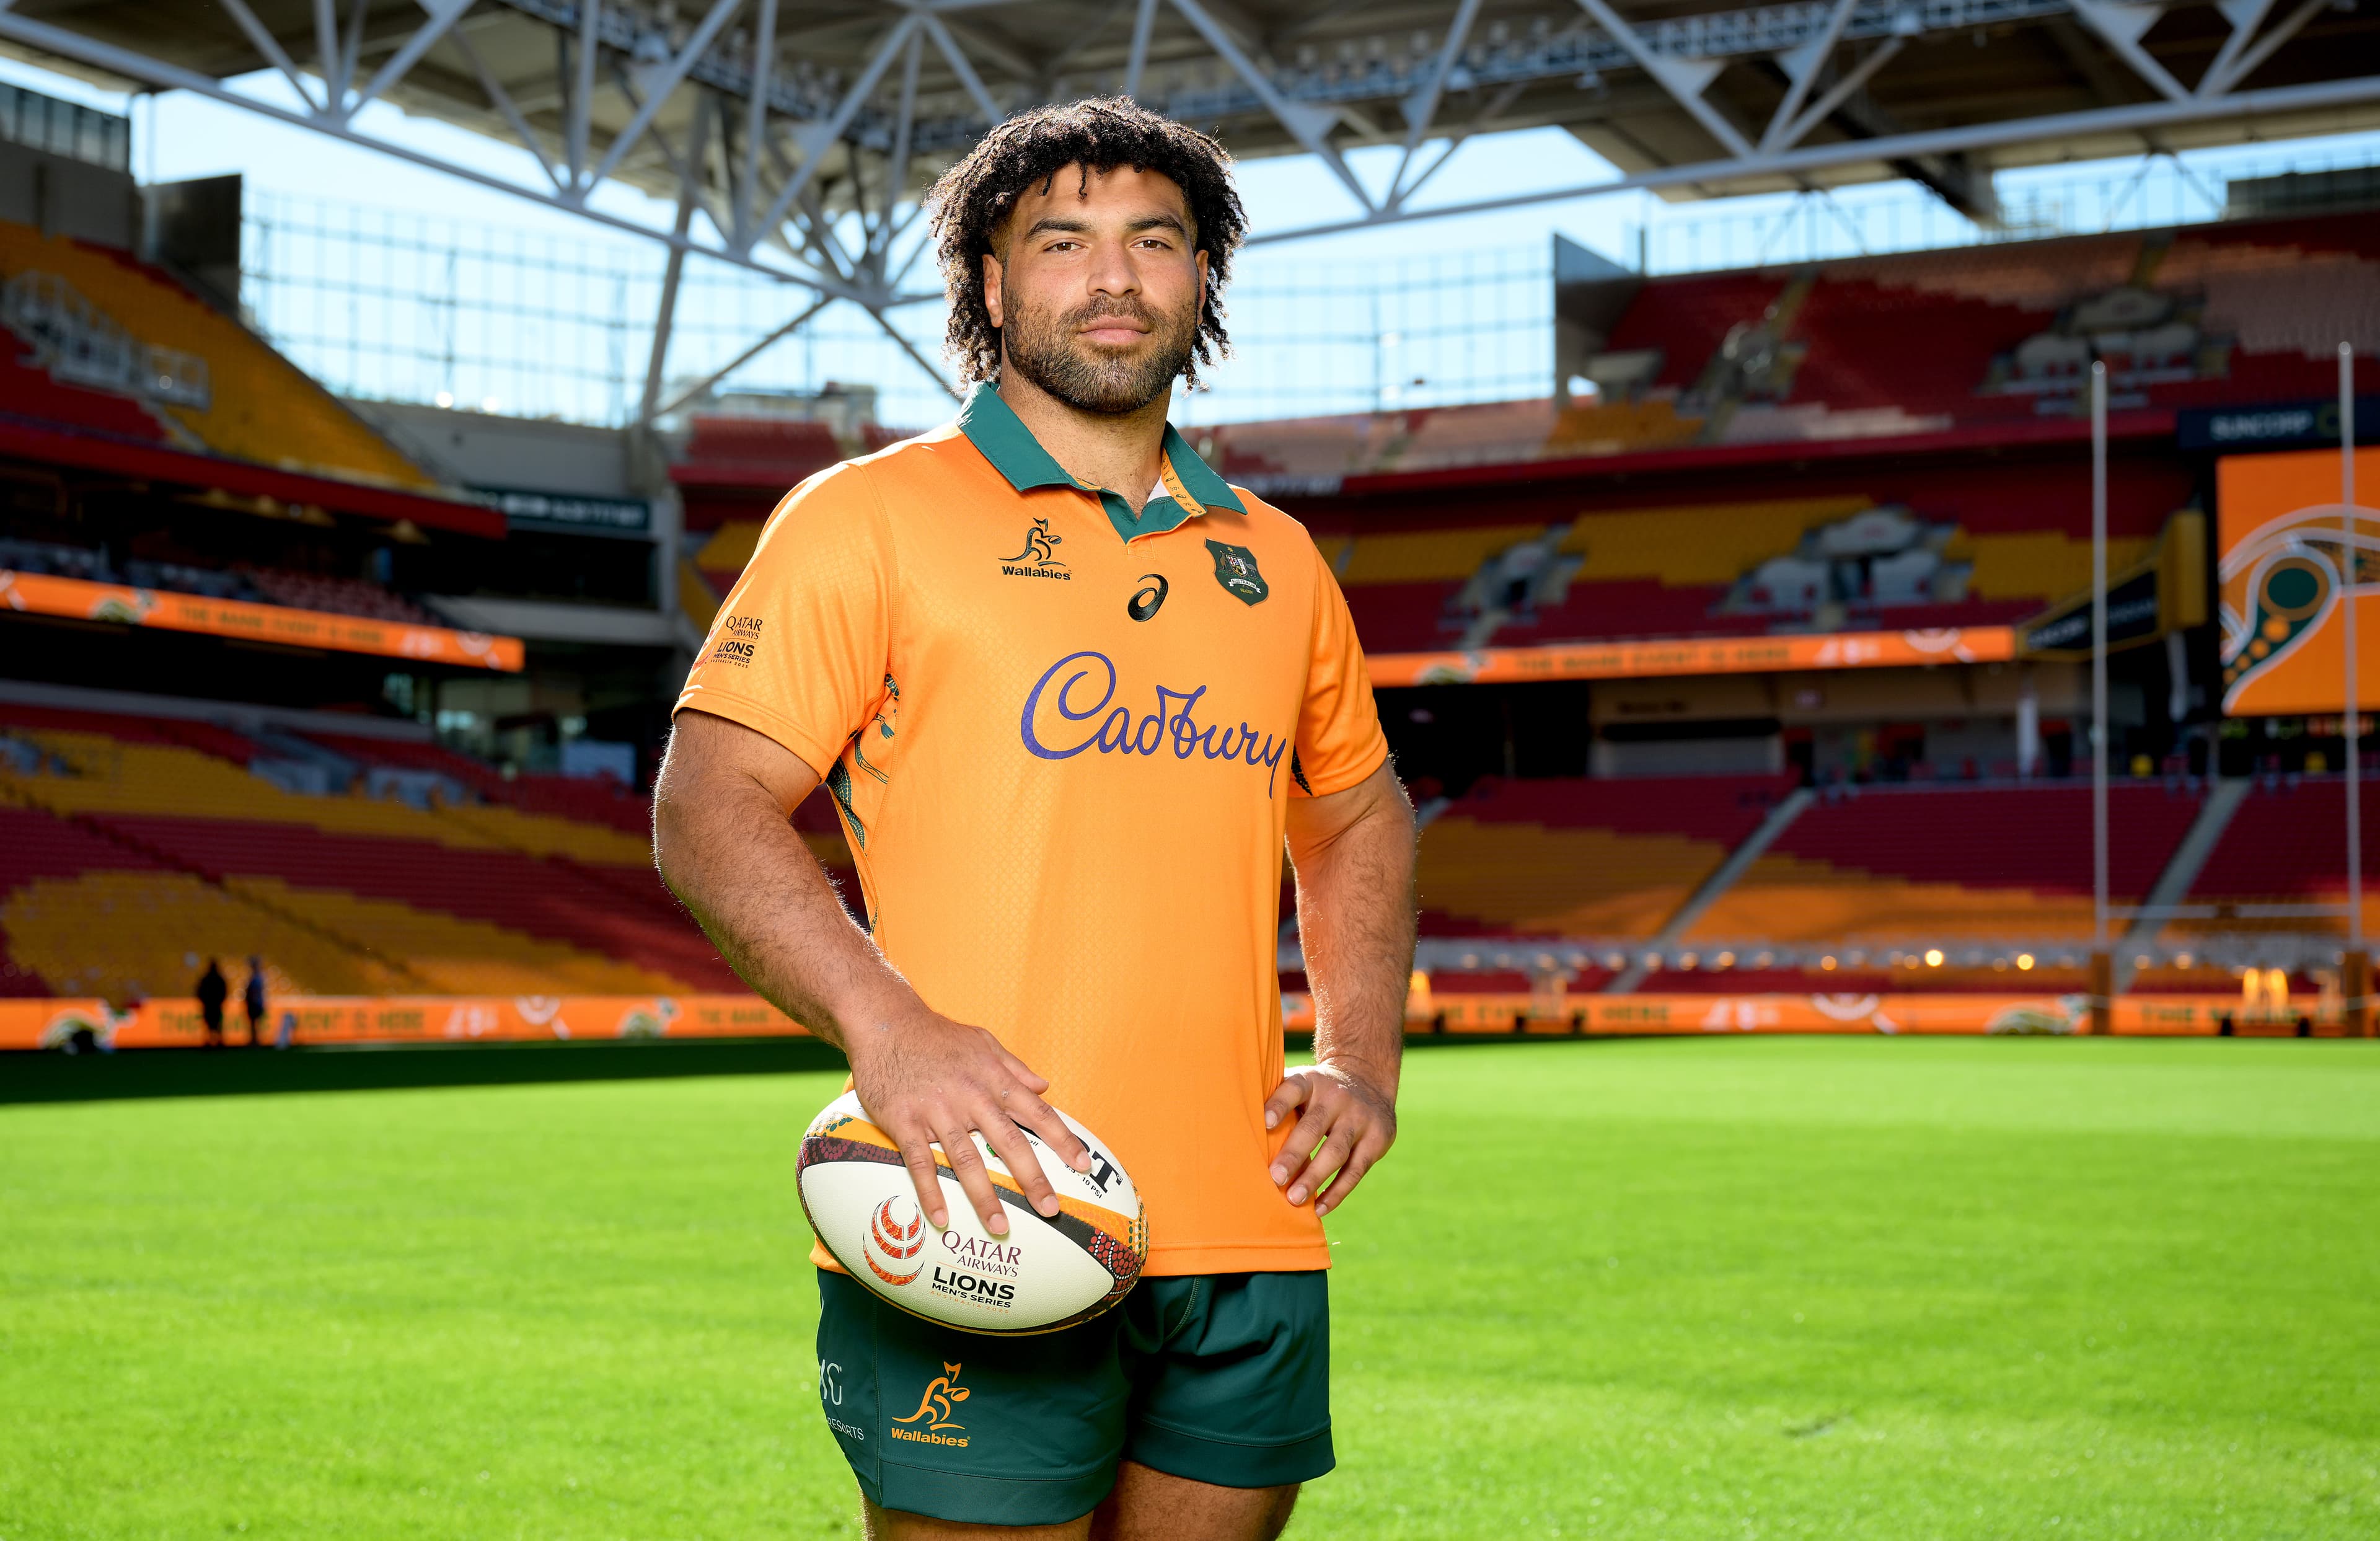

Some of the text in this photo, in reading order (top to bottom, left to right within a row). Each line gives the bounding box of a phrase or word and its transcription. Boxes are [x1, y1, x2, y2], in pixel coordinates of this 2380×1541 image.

[1002, 565, 1071, 581] Wallabies
[1231, 579, 1256, 588] AUSTRALIA
[726, 616, 763, 632] QATAR
[731, 629, 760, 640] AIRWAYS
[717, 641, 755, 657] LIONS
[728, 654, 751, 664] SERIES
[1020, 651, 1287, 800] Cadbury
[1082, 1177, 1090, 1186] 10
[1090, 1185, 1103, 1199] PSI
[941, 1230, 1021, 1265] QATAR
[957, 1255, 1018, 1278] AIRWAYS
[933, 1266, 1015, 1300] LIONS
[930, 1290, 982, 1309] AUSTRALIA
[932, 1283, 1011, 1308] MEN'S SERIES
[827, 1417, 864, 1440] RESORTS
[891, 1428, 969, 1447] Wallabies
